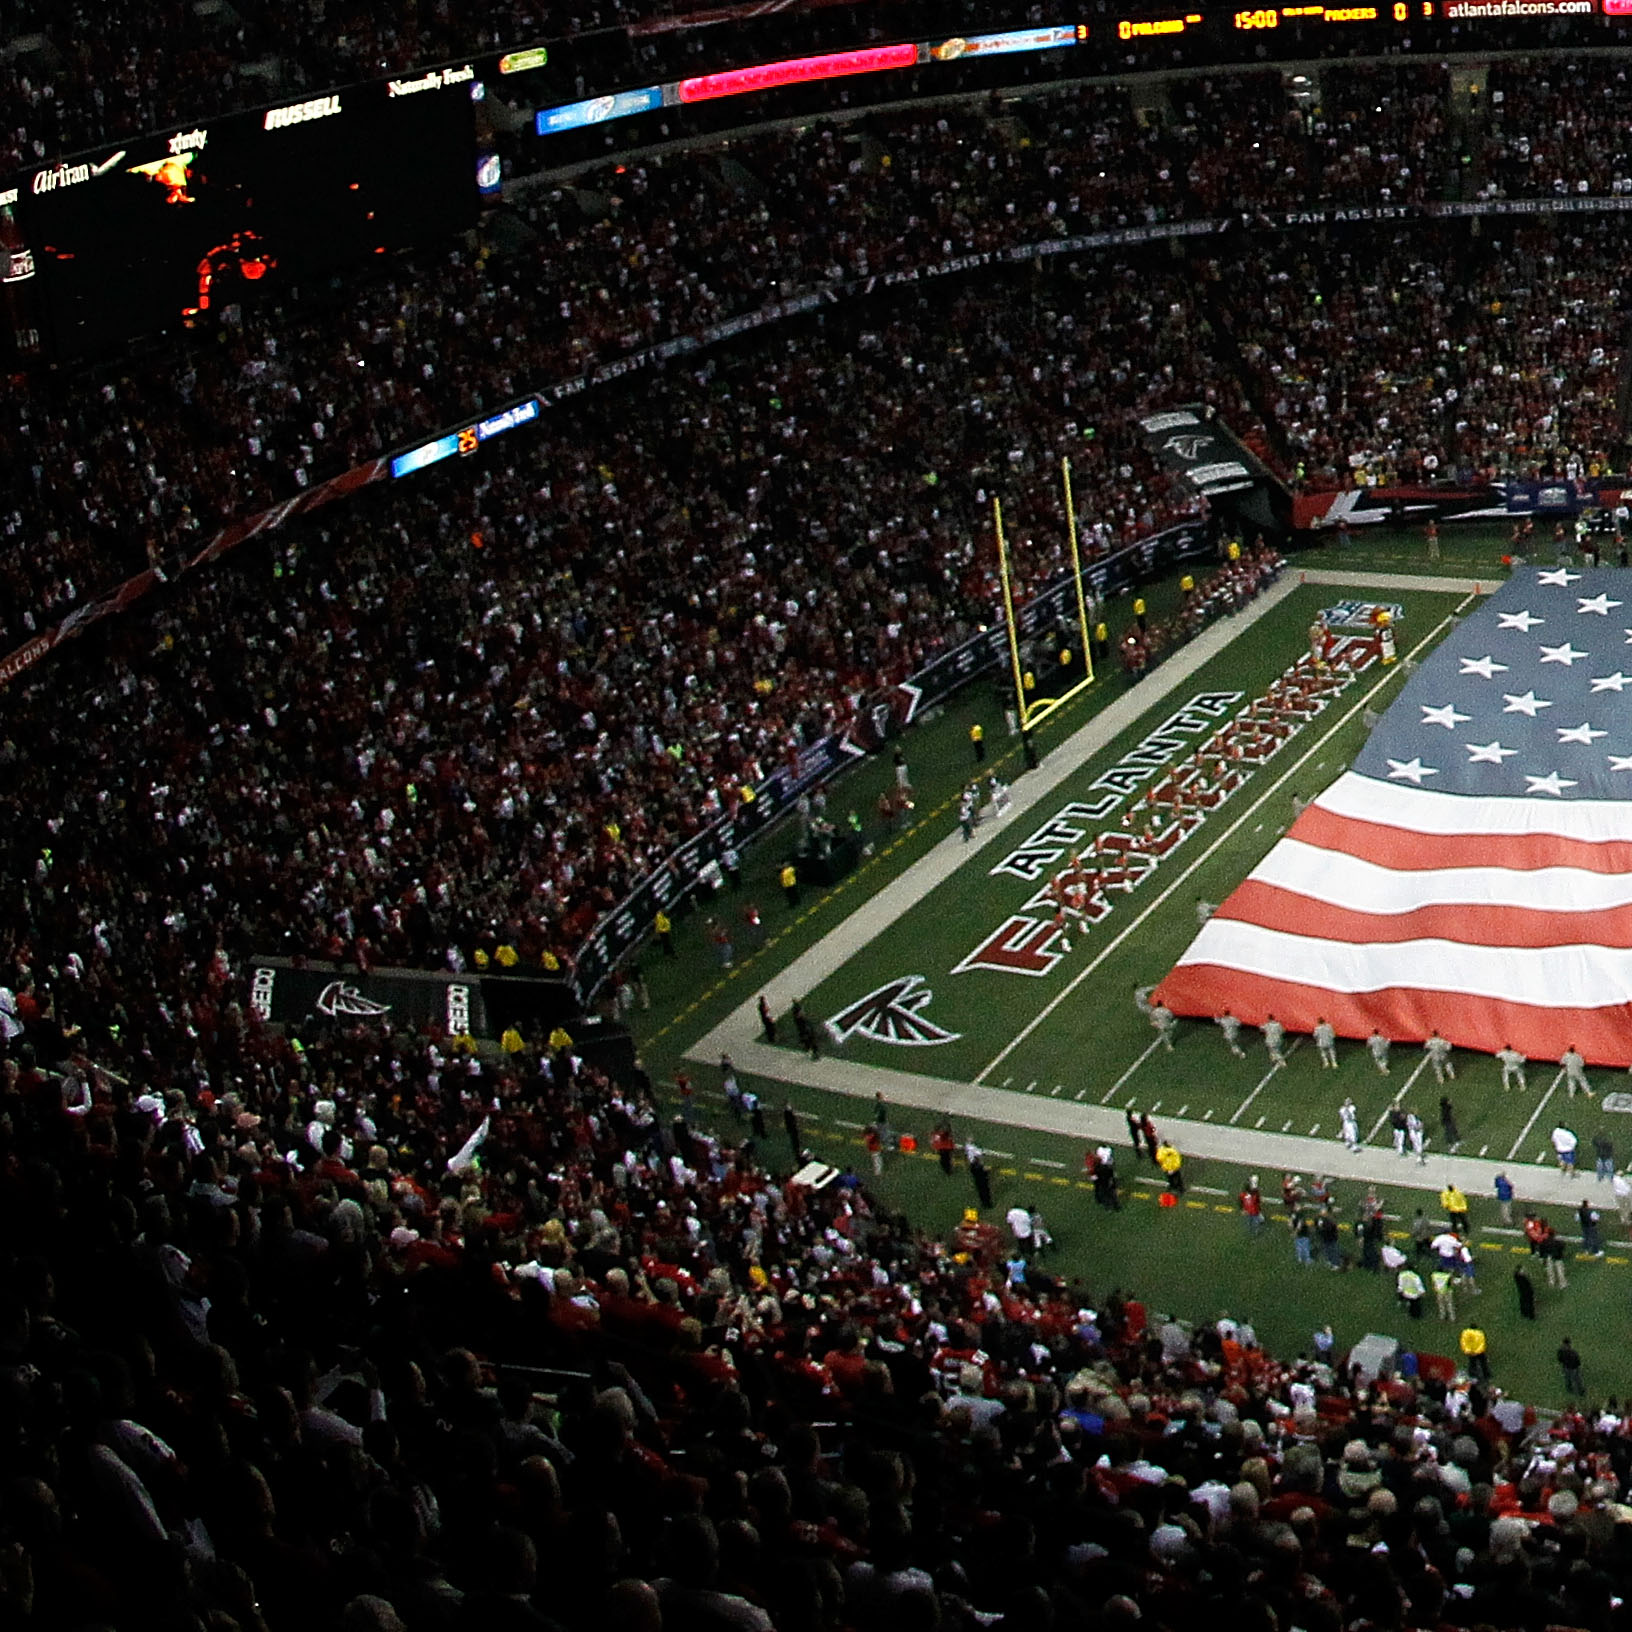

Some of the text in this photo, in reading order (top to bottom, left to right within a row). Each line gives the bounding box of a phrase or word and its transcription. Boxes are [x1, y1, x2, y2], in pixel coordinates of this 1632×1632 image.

[1235, 9, 1278, 29] 15:00
[1448, 0, 1591, 18] atlantafalcons.com
[264, 94, 342, 131] RUSSELL
[989, 690, 1245, 882] ATLANTA
[951, 634, 1385, 977] FALCONS
